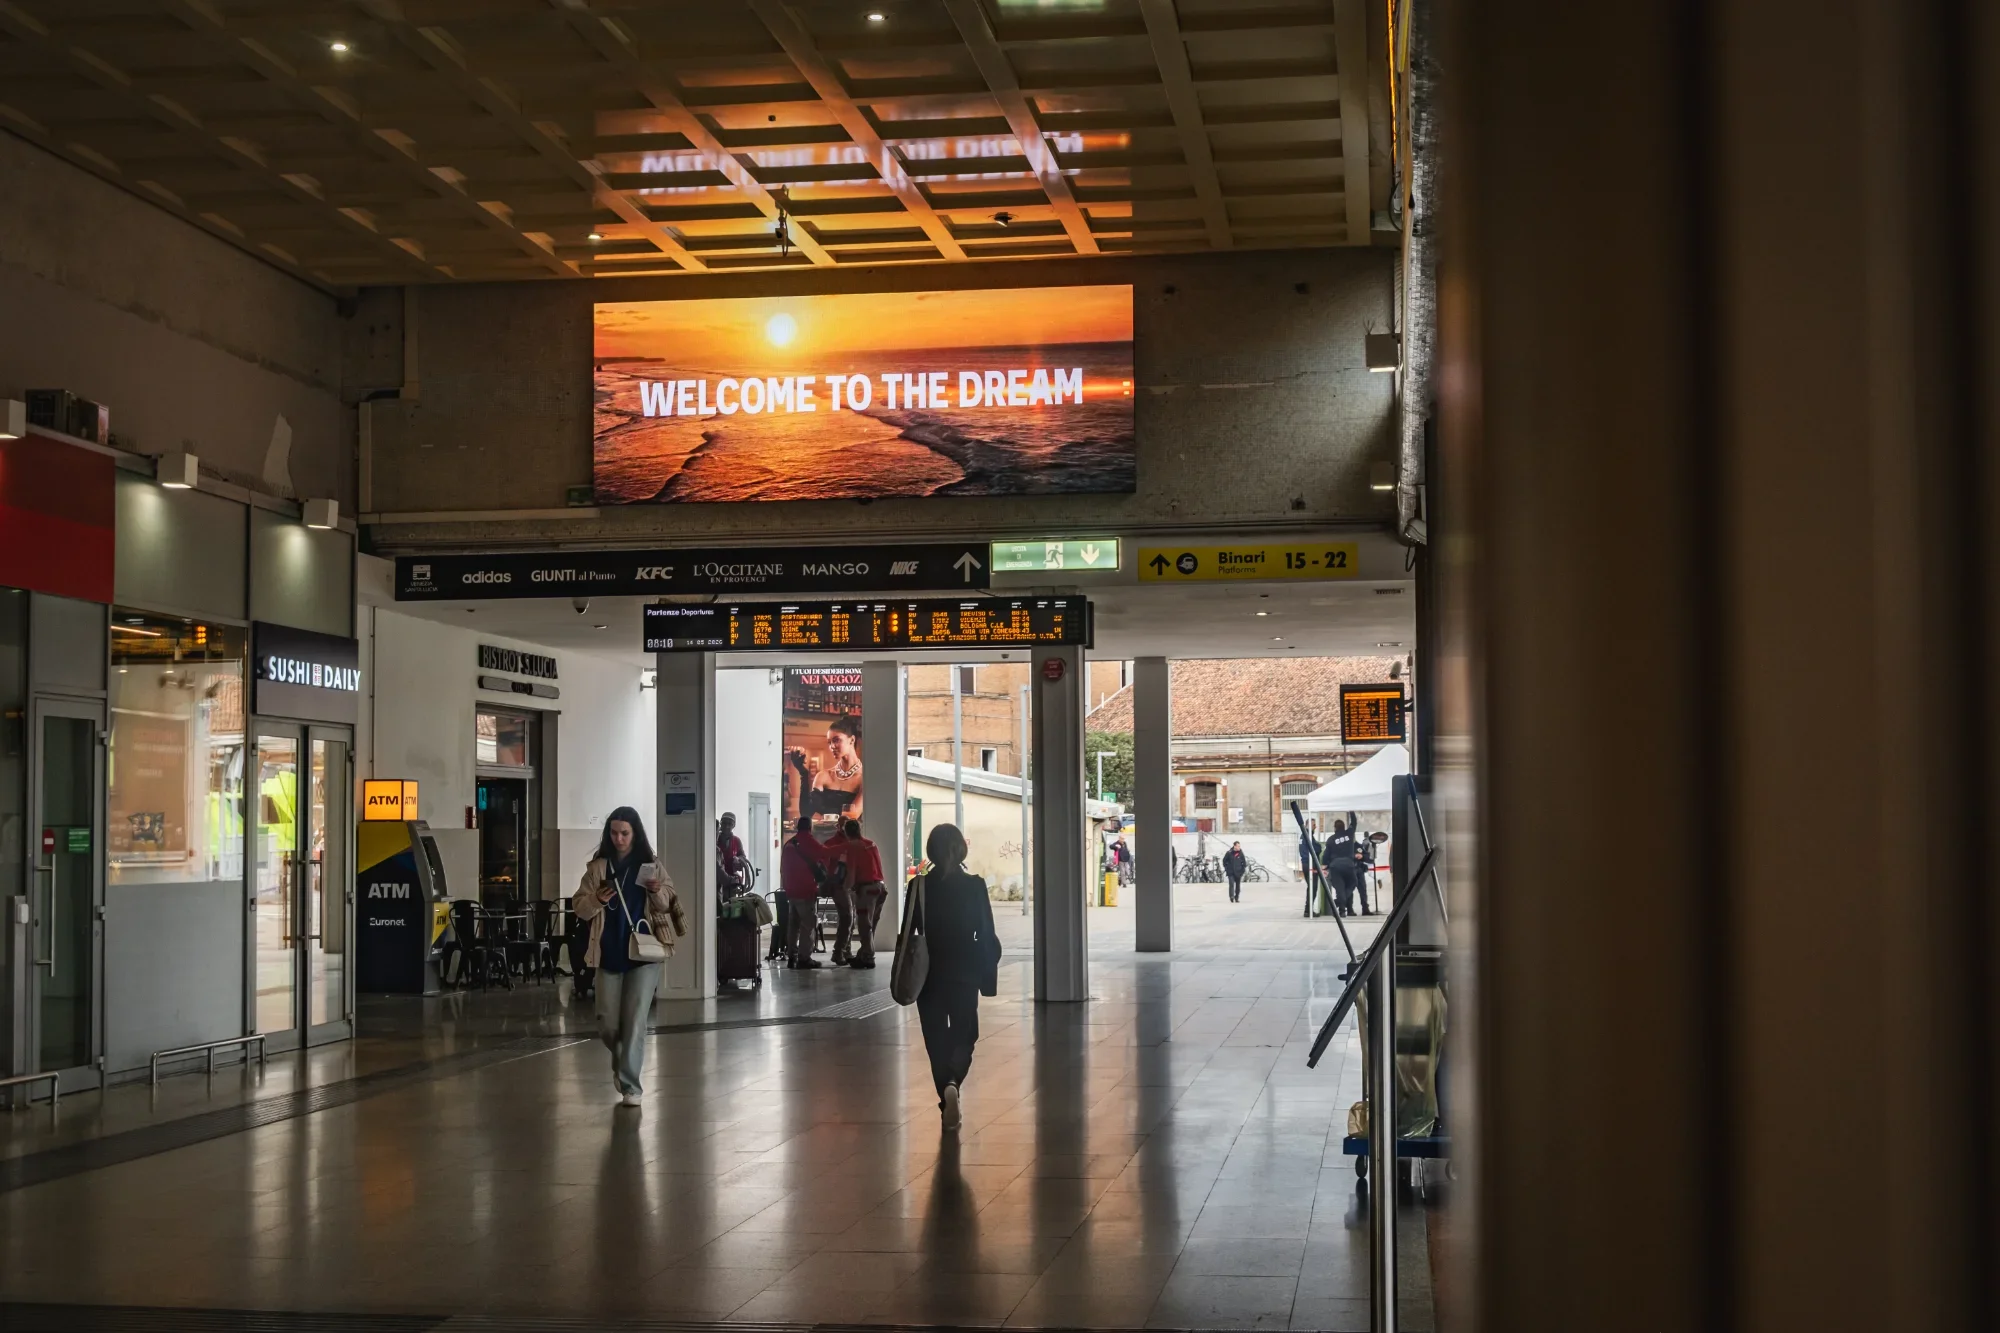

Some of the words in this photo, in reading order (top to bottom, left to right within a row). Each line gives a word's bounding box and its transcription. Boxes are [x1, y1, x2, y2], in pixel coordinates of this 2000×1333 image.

[639, 376, 817, 418] WELCOME
[825, 373, 872, 410] TO
[880, 371, 948, 409] THE
[958, 367, 1083, 408] DREAM
[1218, 551, 1265, 564] Binari
[1285, 551, 1302, 569] 15
[1324, 551, 1347, 568] 22
[635, 566, 674, 580] KFC
[693, 562, 784, 577] L'OCCITANE
[802, 562, 869, 577] MANGO
[890, 560, 919, 576] NIKE
[1218, 565, 1256, 575] Platforms
[462, 570, 512, 584] adidas
[531, 569, 576, 582] GIUNTI
[578, 571, 587, 580] al
[589, 570, 616, 580] Punto
[724, 576, 767, 584] PROVENCE
[647, 639, 674, 648] 08:10
[482, 645, 521, 672] BISTROT
[268, 656, 310, 684] SUSHI
[324, 665, 360, 691] DAILY
[801, 675, 820, 684] NEI
[368, 796, 399, 806] ATM
[404, 796, 416, 805] ATM
[368, 883, 410, 898] ATM
[436, 915, 446, 925] ATM
